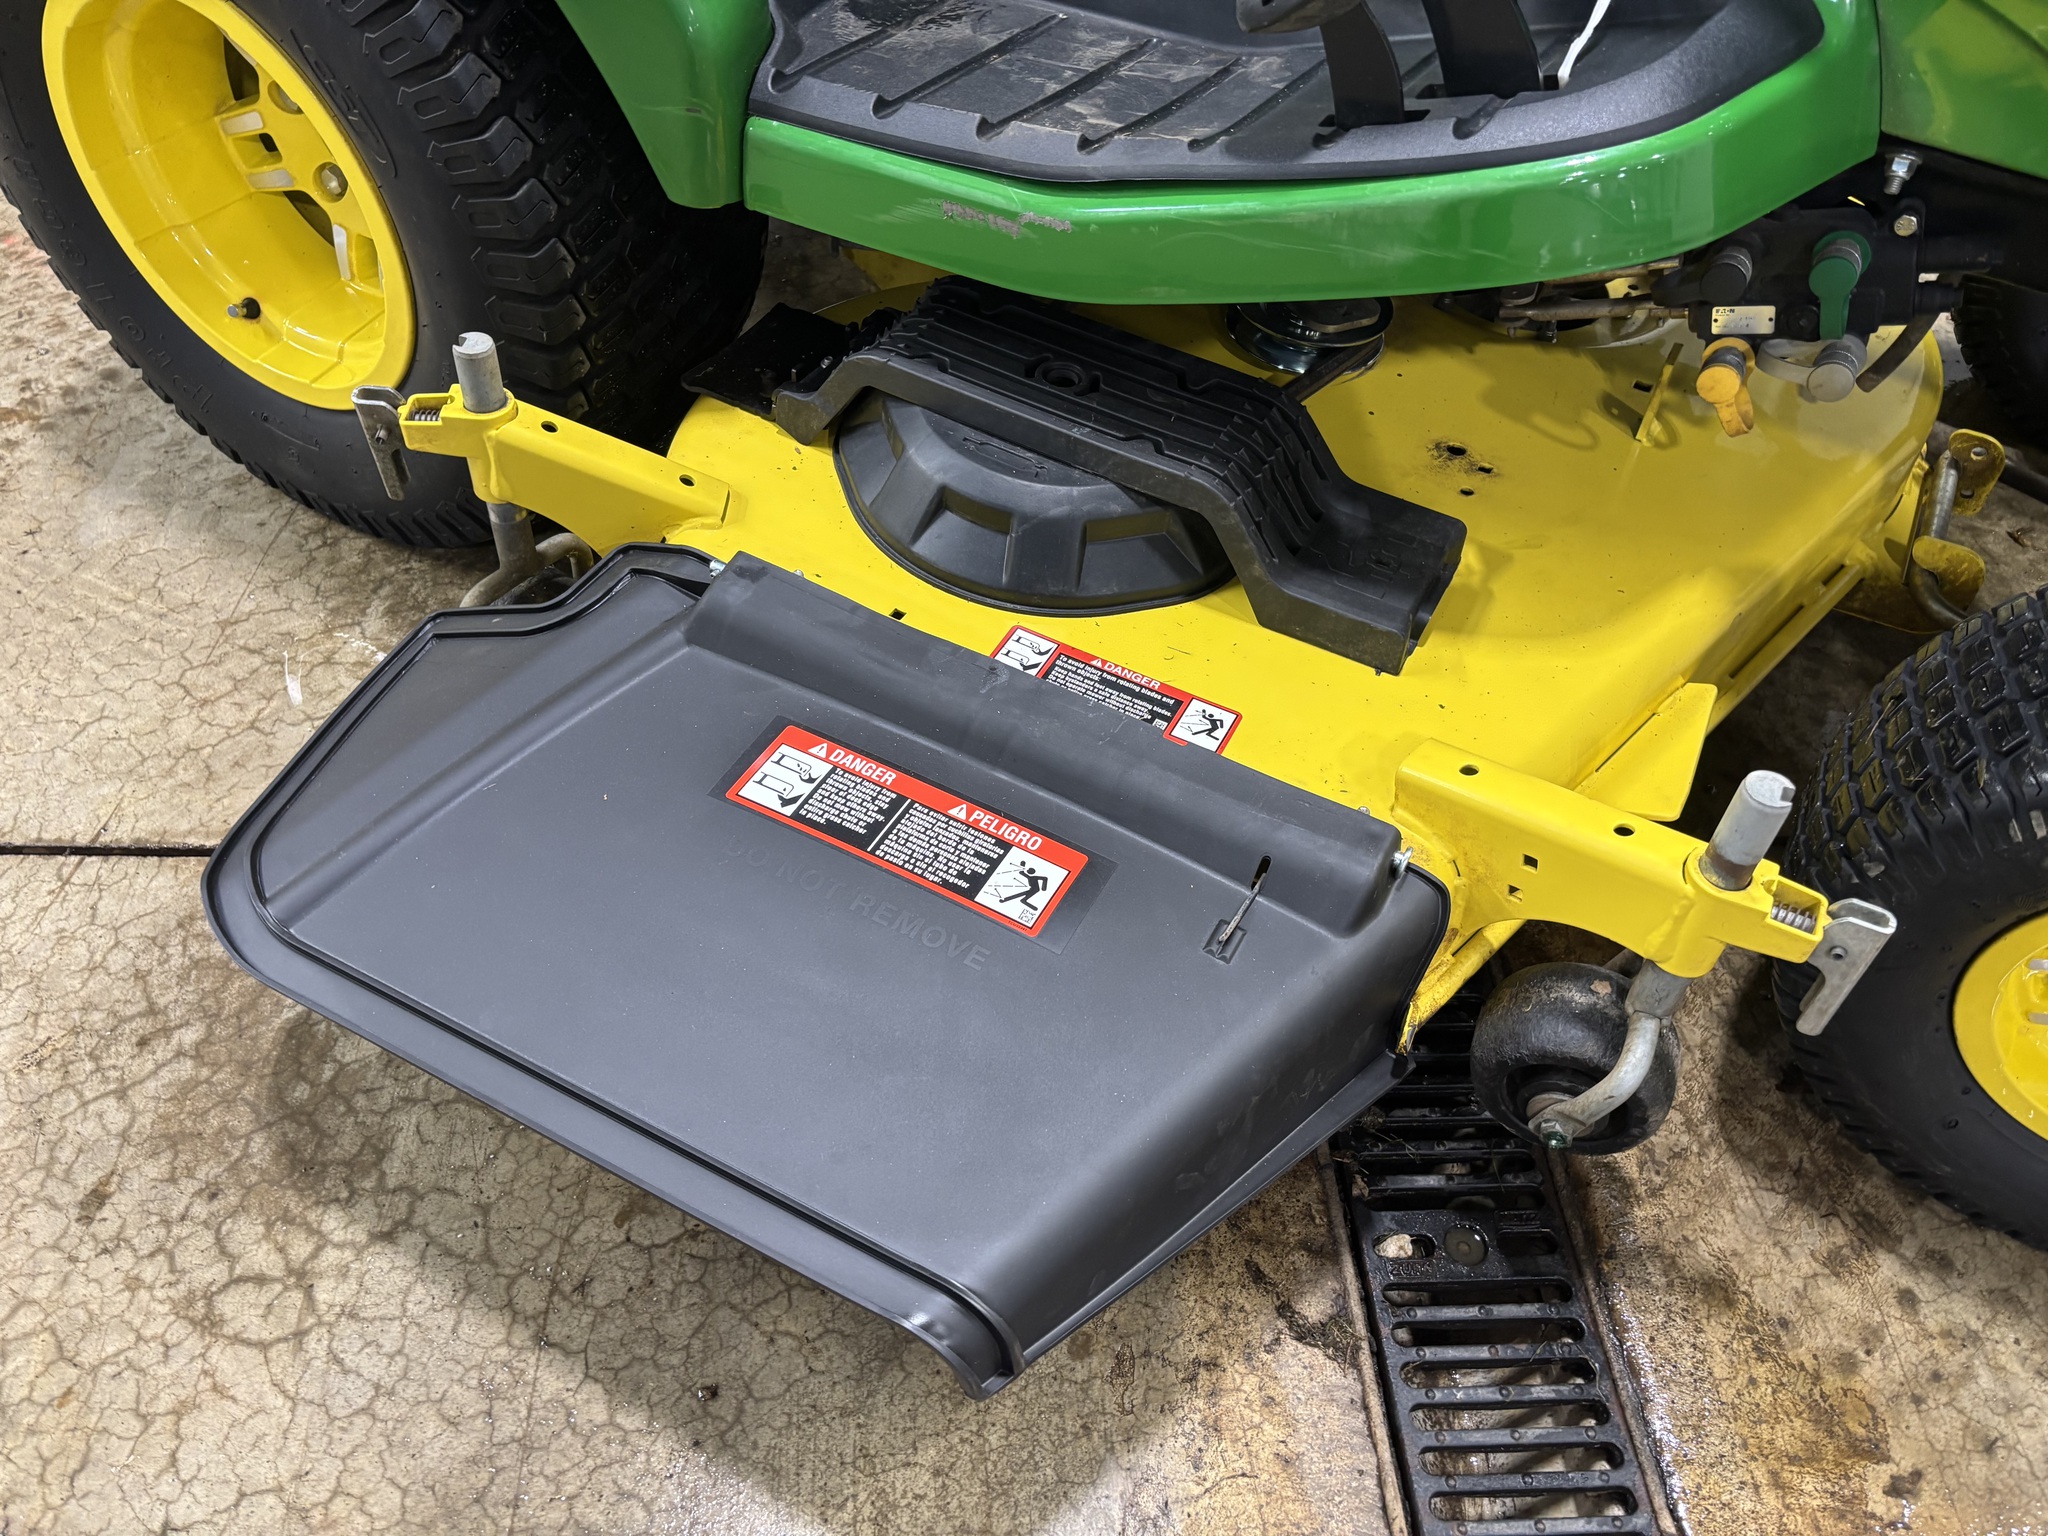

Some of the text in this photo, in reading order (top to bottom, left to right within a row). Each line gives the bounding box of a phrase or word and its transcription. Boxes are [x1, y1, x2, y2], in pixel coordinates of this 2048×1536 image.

[1050, 669, 1065, 679] Keep
[1064, 675, 1093, 690] bystanders
[1097, 689, 1110, 697] safe
[1110, 694, 1133, 706] distance
[1053, 665, 1067, 674] Keep
[1067, 671, 1083, 681] hands
[1104, 687, 1119, 695] away
[1118, 692, 1132, 700] from
[1131, 697, 1153, 709] rotating
[1055, 659, 1101, 681] thrown objects:
[1067, 658, 1085, 668] avoid
[1084, 664, 1102, 676] injury
[1101, 672, 1117, 681] from
[1116, 678, 1140, 692] rotating
[1140, 687, 1161, 699] blades
[1161, 696, 1175, 704] and
[1103, 662, 1160, 689] DANGER
[1065, 681, 1086, 692] operate
[1085, 690, 1105, 700] mower
[1104, 697, 1125, 708] without
[828, 748, 896, 785] DANGER
[834, 767, 897, 798] To avoid injury from
[816, 786, 885, 822] and keep others away.
[820, 783, 839, 793] clear
[845, 793, 862, 804] deck
[861, 800, 878, 811] edge
[825, 777, 848, 791] thrown
[873, 799, 889, 809] stay
[829, 773, 891, 802] rotating blades and
[798, 807, 826, 824] in place.
[803, 803, 867, 834] entire grass catcher
[807, 797, 839, 815] discharge
[839, 812, 858, 823] chute
[812, 792, 875, 823] Do not mow without
[912, 802, 996, 843] Para evitar sufrir lesiones
[895, 823, 929, 842] plataforma
[937, 842, 955, 853] corte
[959, 851, 990, 868] mantener
[900, 817, 974, 855] alejado del borde de la
[907, 815, 932, 829] objetos
[961, 839, 998, 858] mantenerse
[934, 820, 948, 828] por
[947, 825, 975, 841] cuchillas
[973, 837, 1004, 854] giratorias
[968, 810, 1042, 850] PELIGRO
[874, 849, 942, 884] de pasto en su lugar.
[879, 844, 909, 861] descarga
[915, 860, 927, 869] sin
[935, 869, 969, 888] recogedor
[887, 833, 897, 841] de
[936, 854, 947, 863] No
[947, 860, 963, 870] usar
[963, 866, 971, 875] la
[897, 830, 908, 839] las
[928, 845, 958, 861] personas
[958, 858, 986, 874] alejadas
[912, 850, 924, 860] sin
[931, 860, 948, 871] tubo
[947, 867, 957, 875] de
[775, 857, 848, 900] NOT
[849, 886, 993, 972] REMOVE
